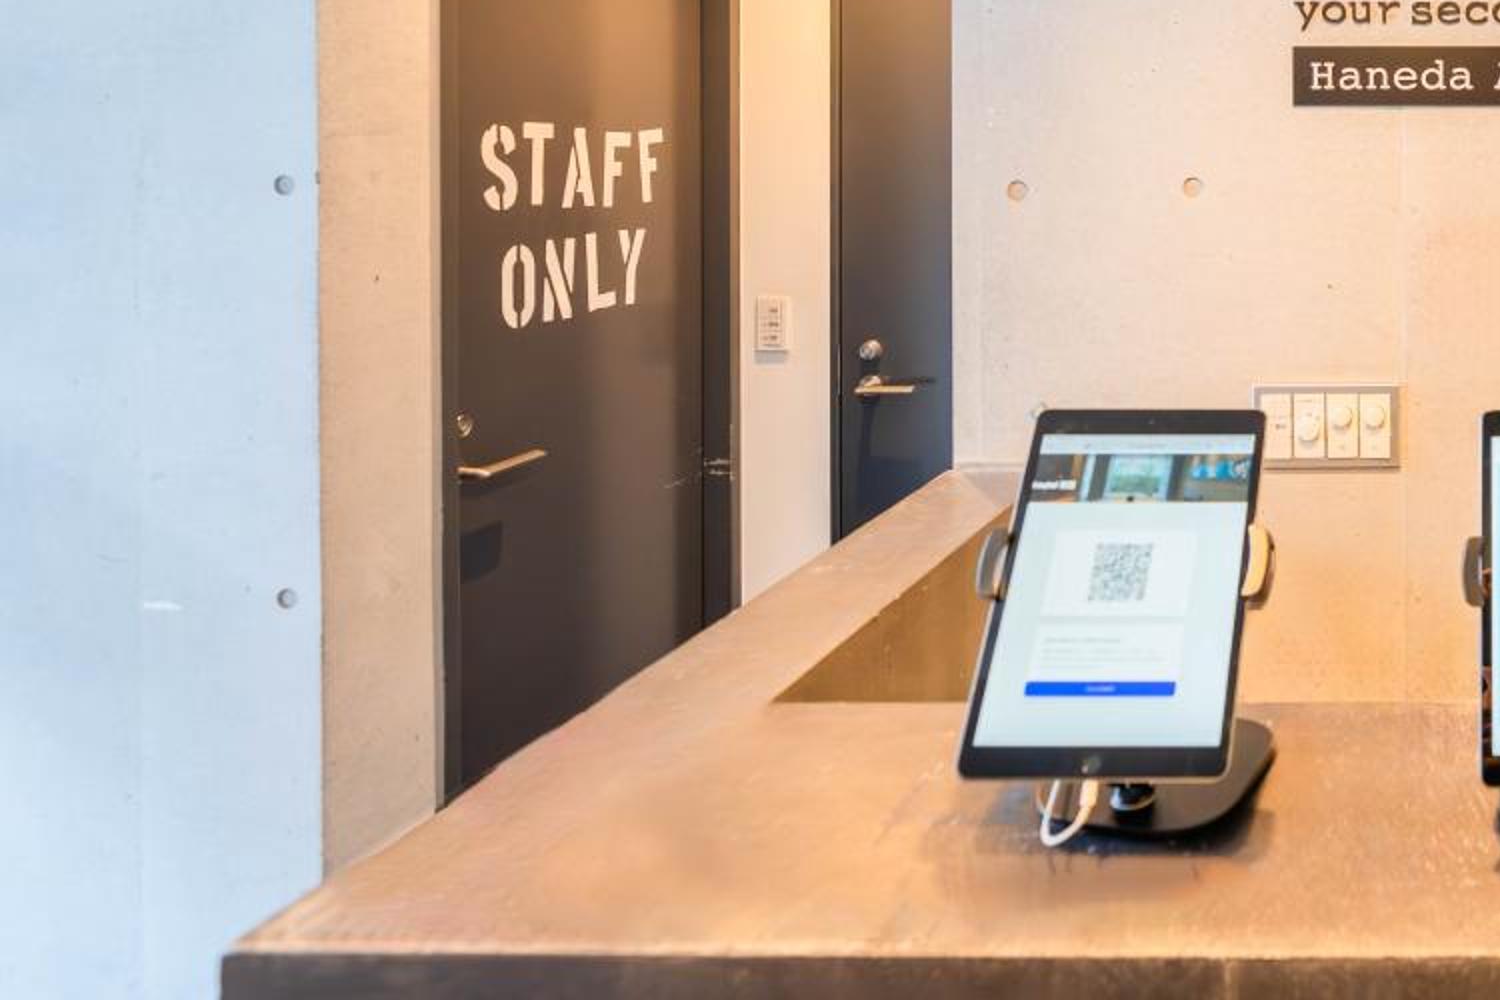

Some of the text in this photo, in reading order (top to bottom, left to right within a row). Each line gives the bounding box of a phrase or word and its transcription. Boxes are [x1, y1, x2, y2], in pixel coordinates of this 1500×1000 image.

[1310, 59, 1474, 91] Haneda
[481, 121, 664, 211] STAFF
[501, 228, 646, 328] ONLY
